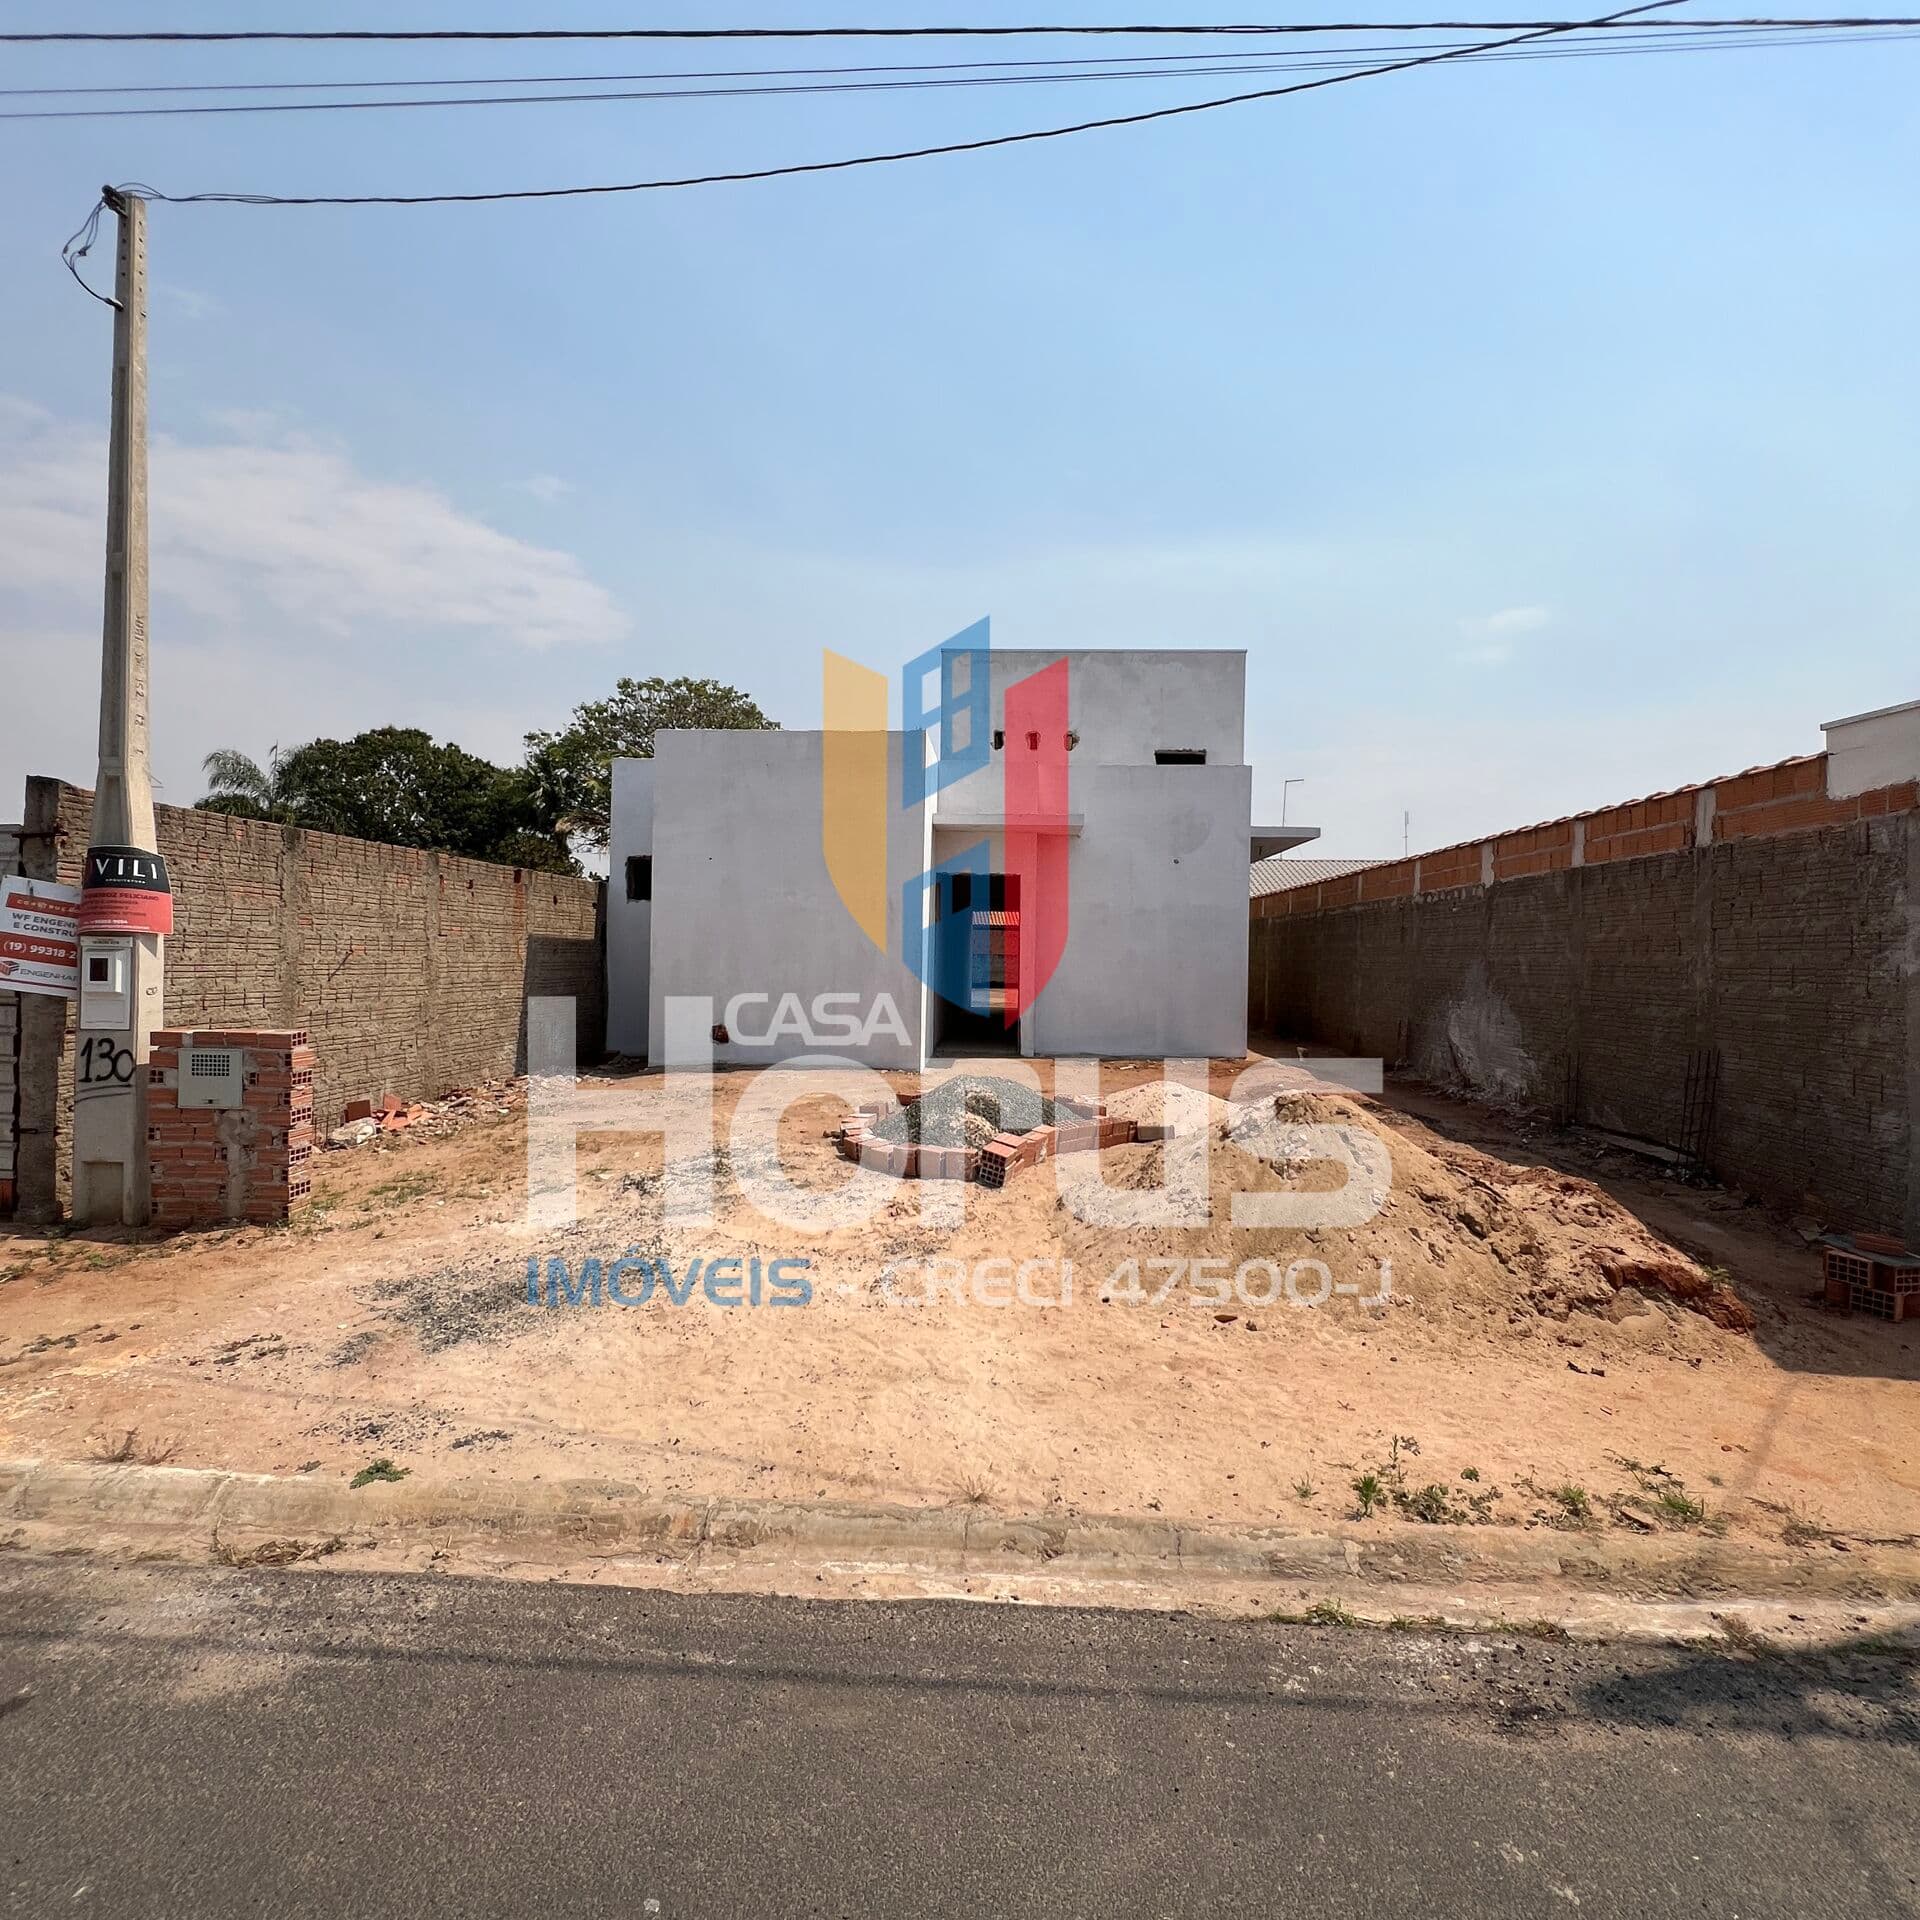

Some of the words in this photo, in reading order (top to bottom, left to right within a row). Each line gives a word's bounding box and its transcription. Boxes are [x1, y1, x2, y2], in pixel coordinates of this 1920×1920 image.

[12, 912, 31, 921] WF
[13, 921, 20, 929] E
[3, 940, 27, 953] (19)
[78, 1037, 136, 1083] 130
